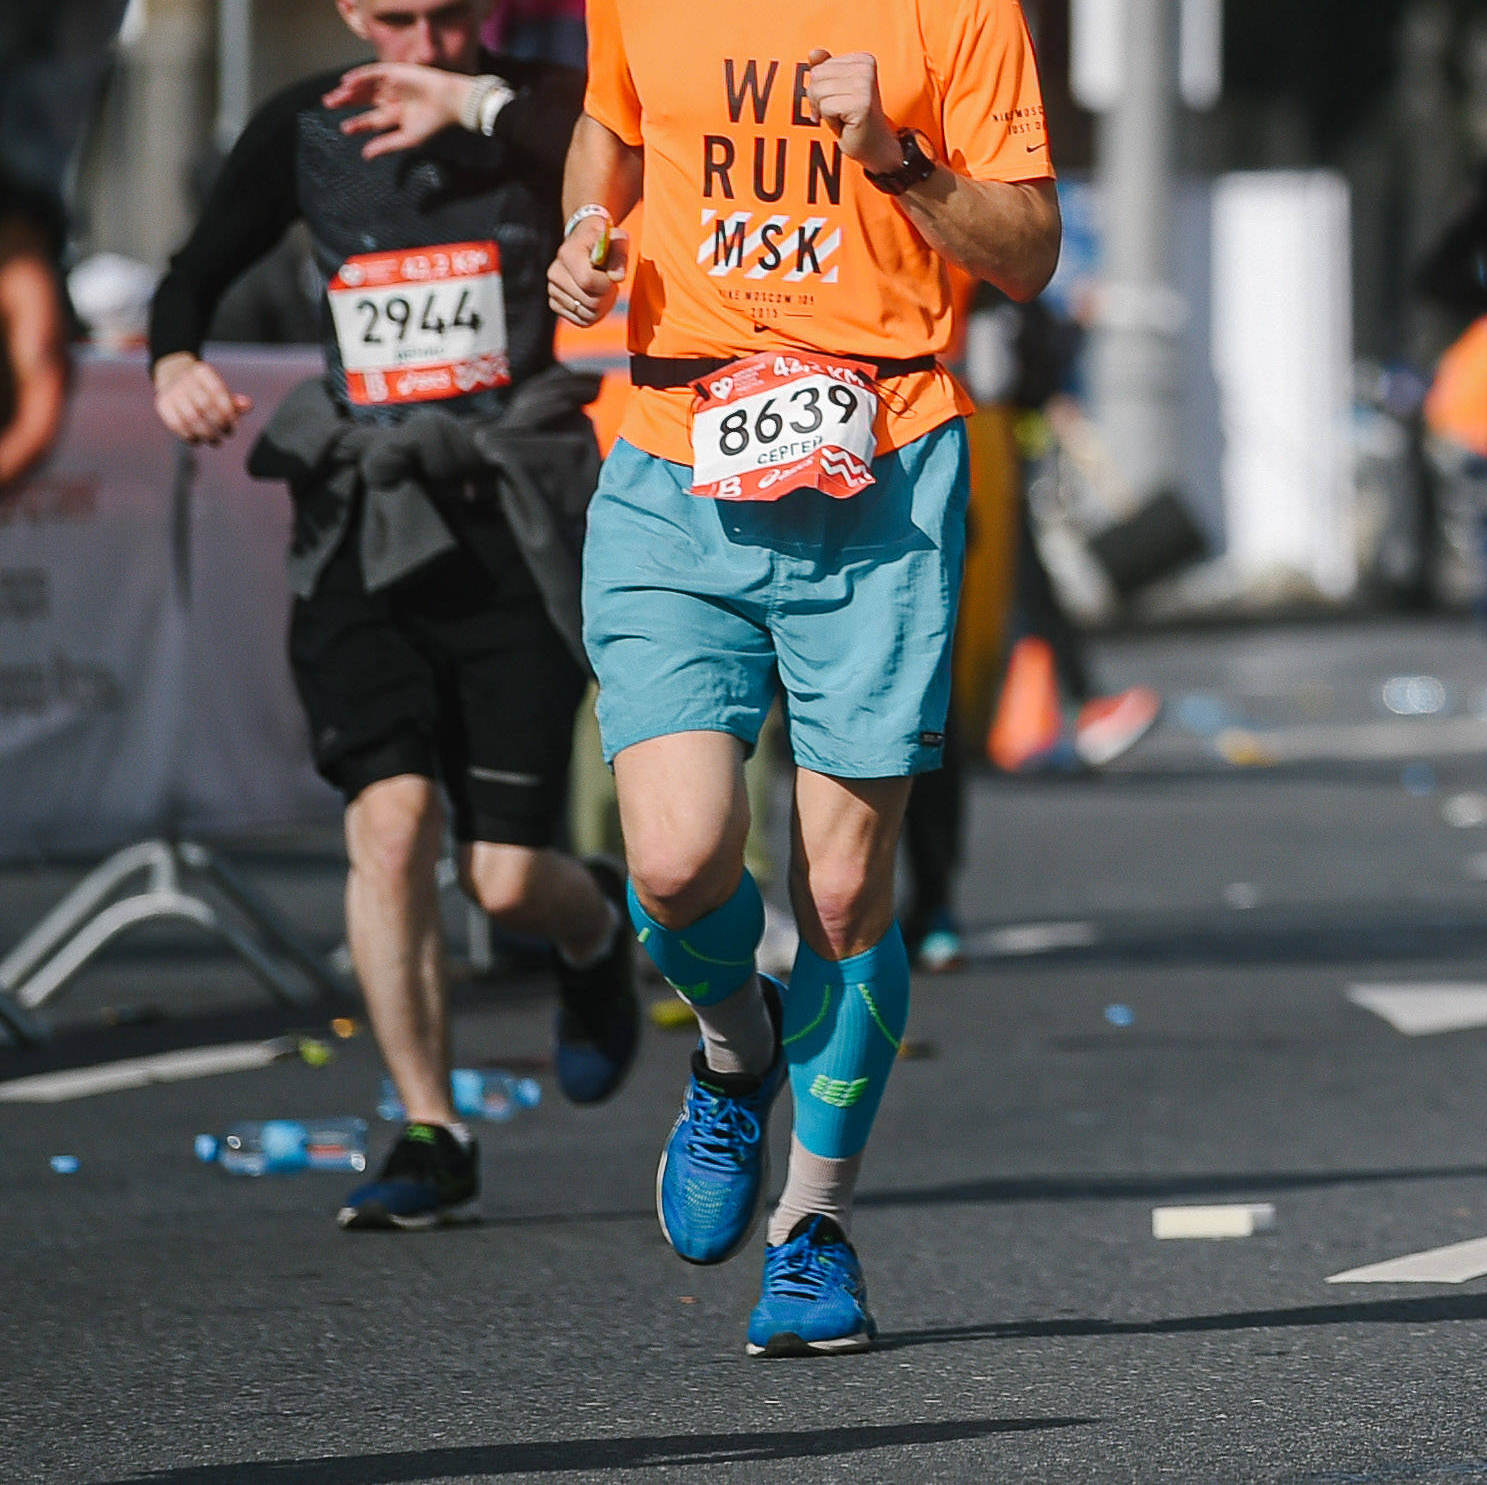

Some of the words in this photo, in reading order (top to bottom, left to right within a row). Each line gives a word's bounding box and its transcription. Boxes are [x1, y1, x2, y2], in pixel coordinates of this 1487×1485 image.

[724, 59, 820, 127] WE
[703, 134, 842, 205] RUN
[713, 218, 822, 274] MSK
[356, 288, 483, 344] 2944
[719, 384, 858, 457] 8639
